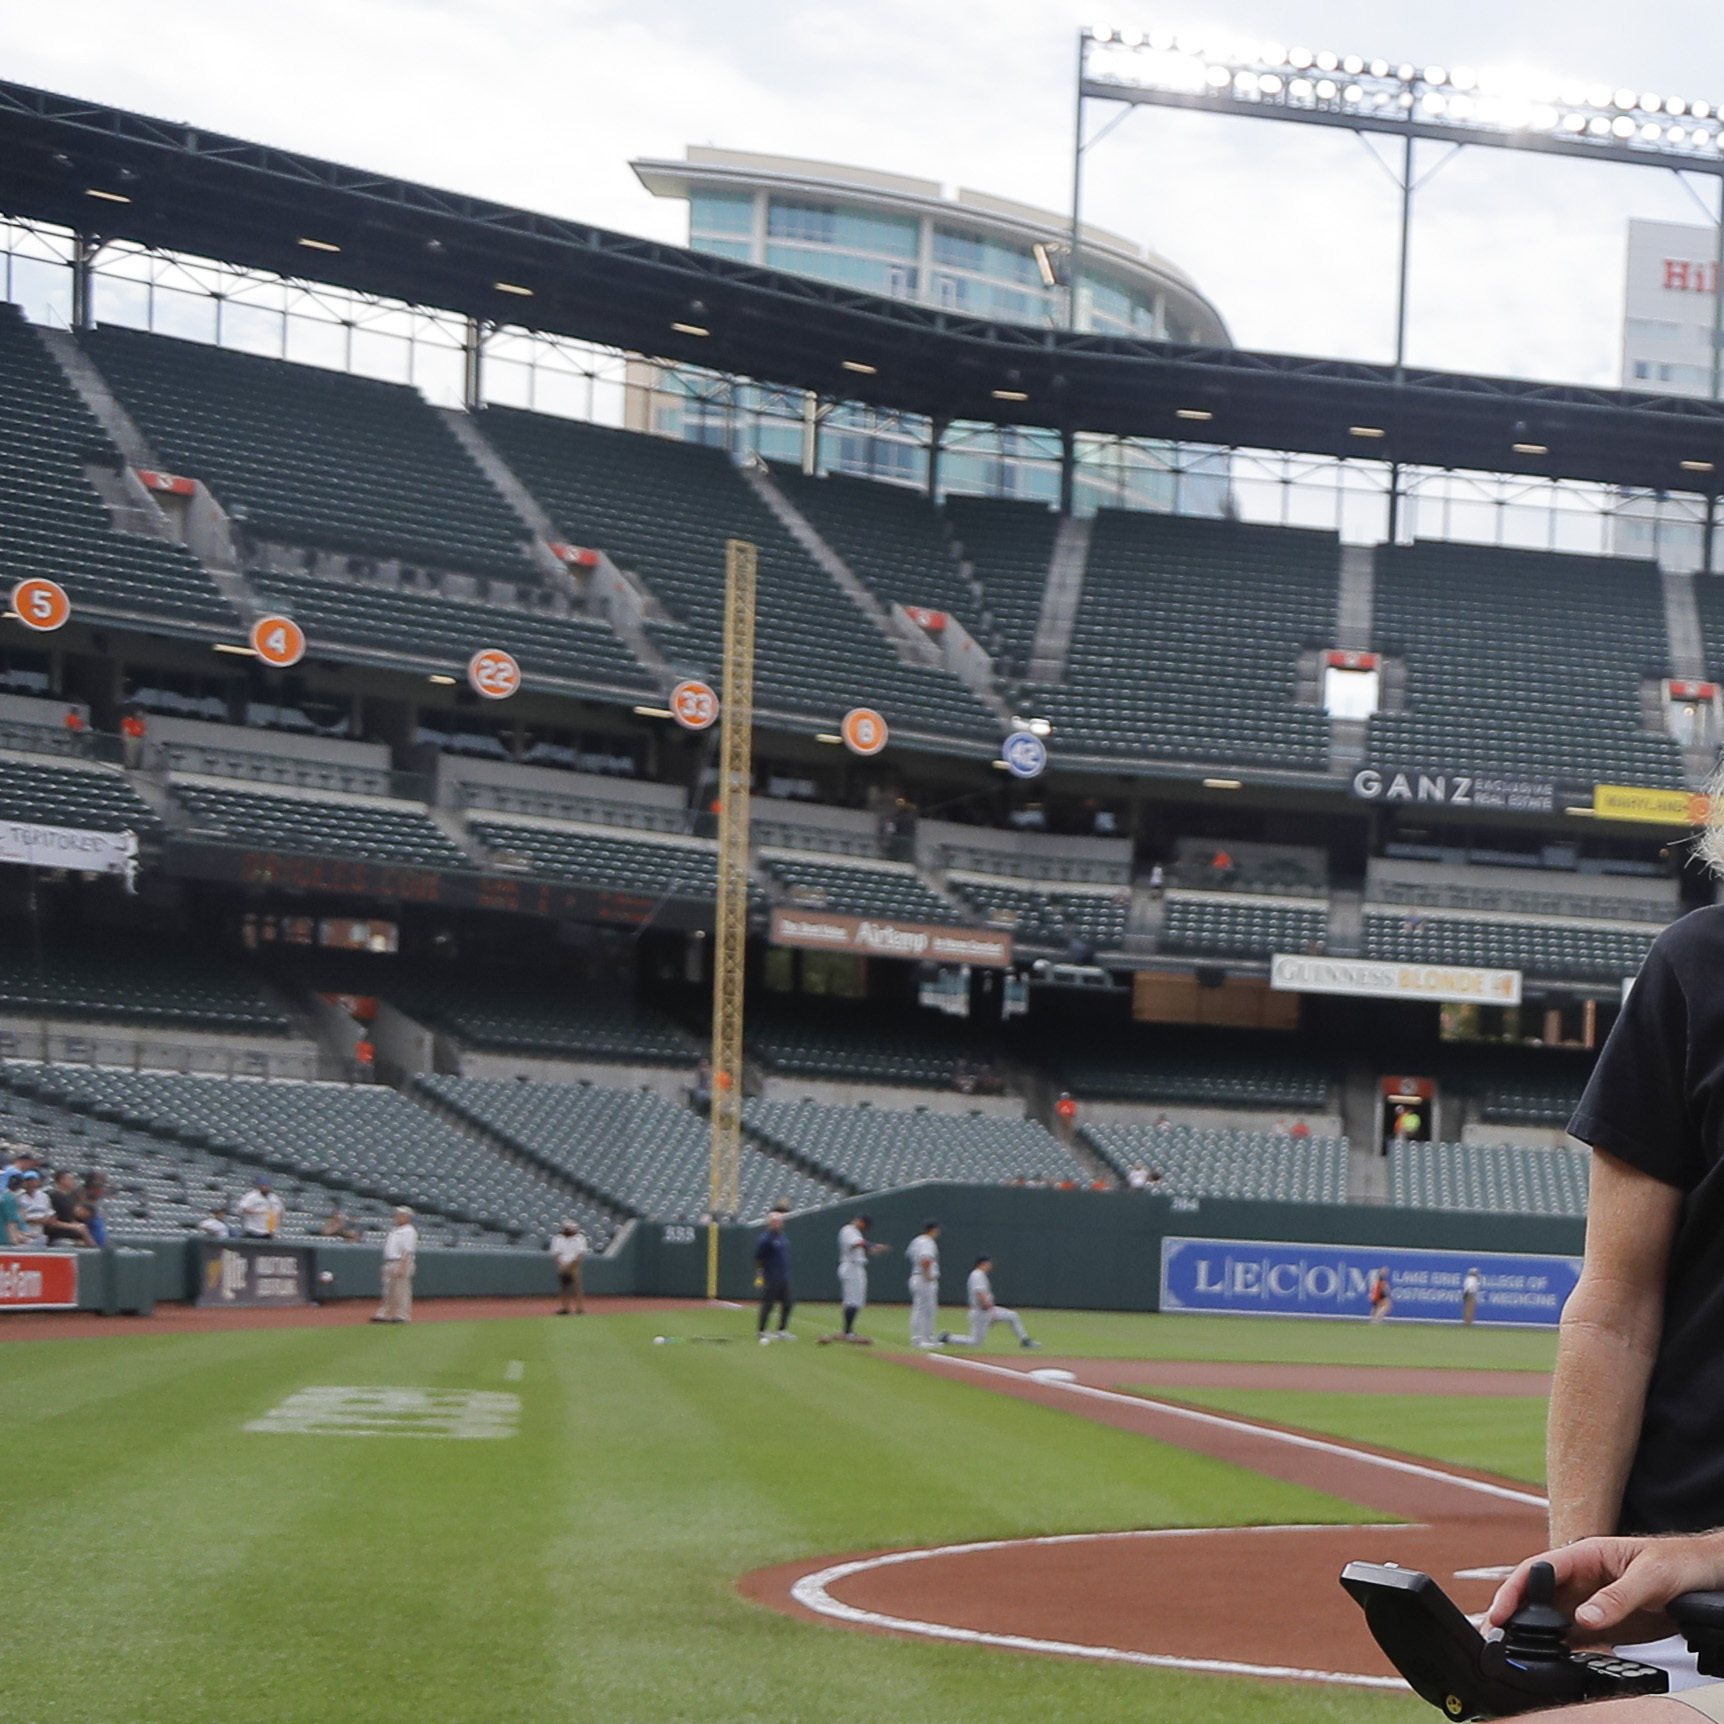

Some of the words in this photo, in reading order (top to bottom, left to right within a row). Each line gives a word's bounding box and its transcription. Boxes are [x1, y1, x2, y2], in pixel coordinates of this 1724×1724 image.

[31, 589, 52, 618] 5
[266, 627, 287, 654] 4
[476, 658, 515, 688] 22
[677, 691, 711, 719] 33
[1353, 769, 1474, 806] GANZ
[1276, 957, 1394, 987] GUINNESS
[1398, 967, 1485, 994] BLONDE
[1391, 1270, 1429, 1285] LAKE
[1527, 1276, 1548, 1290] OF
